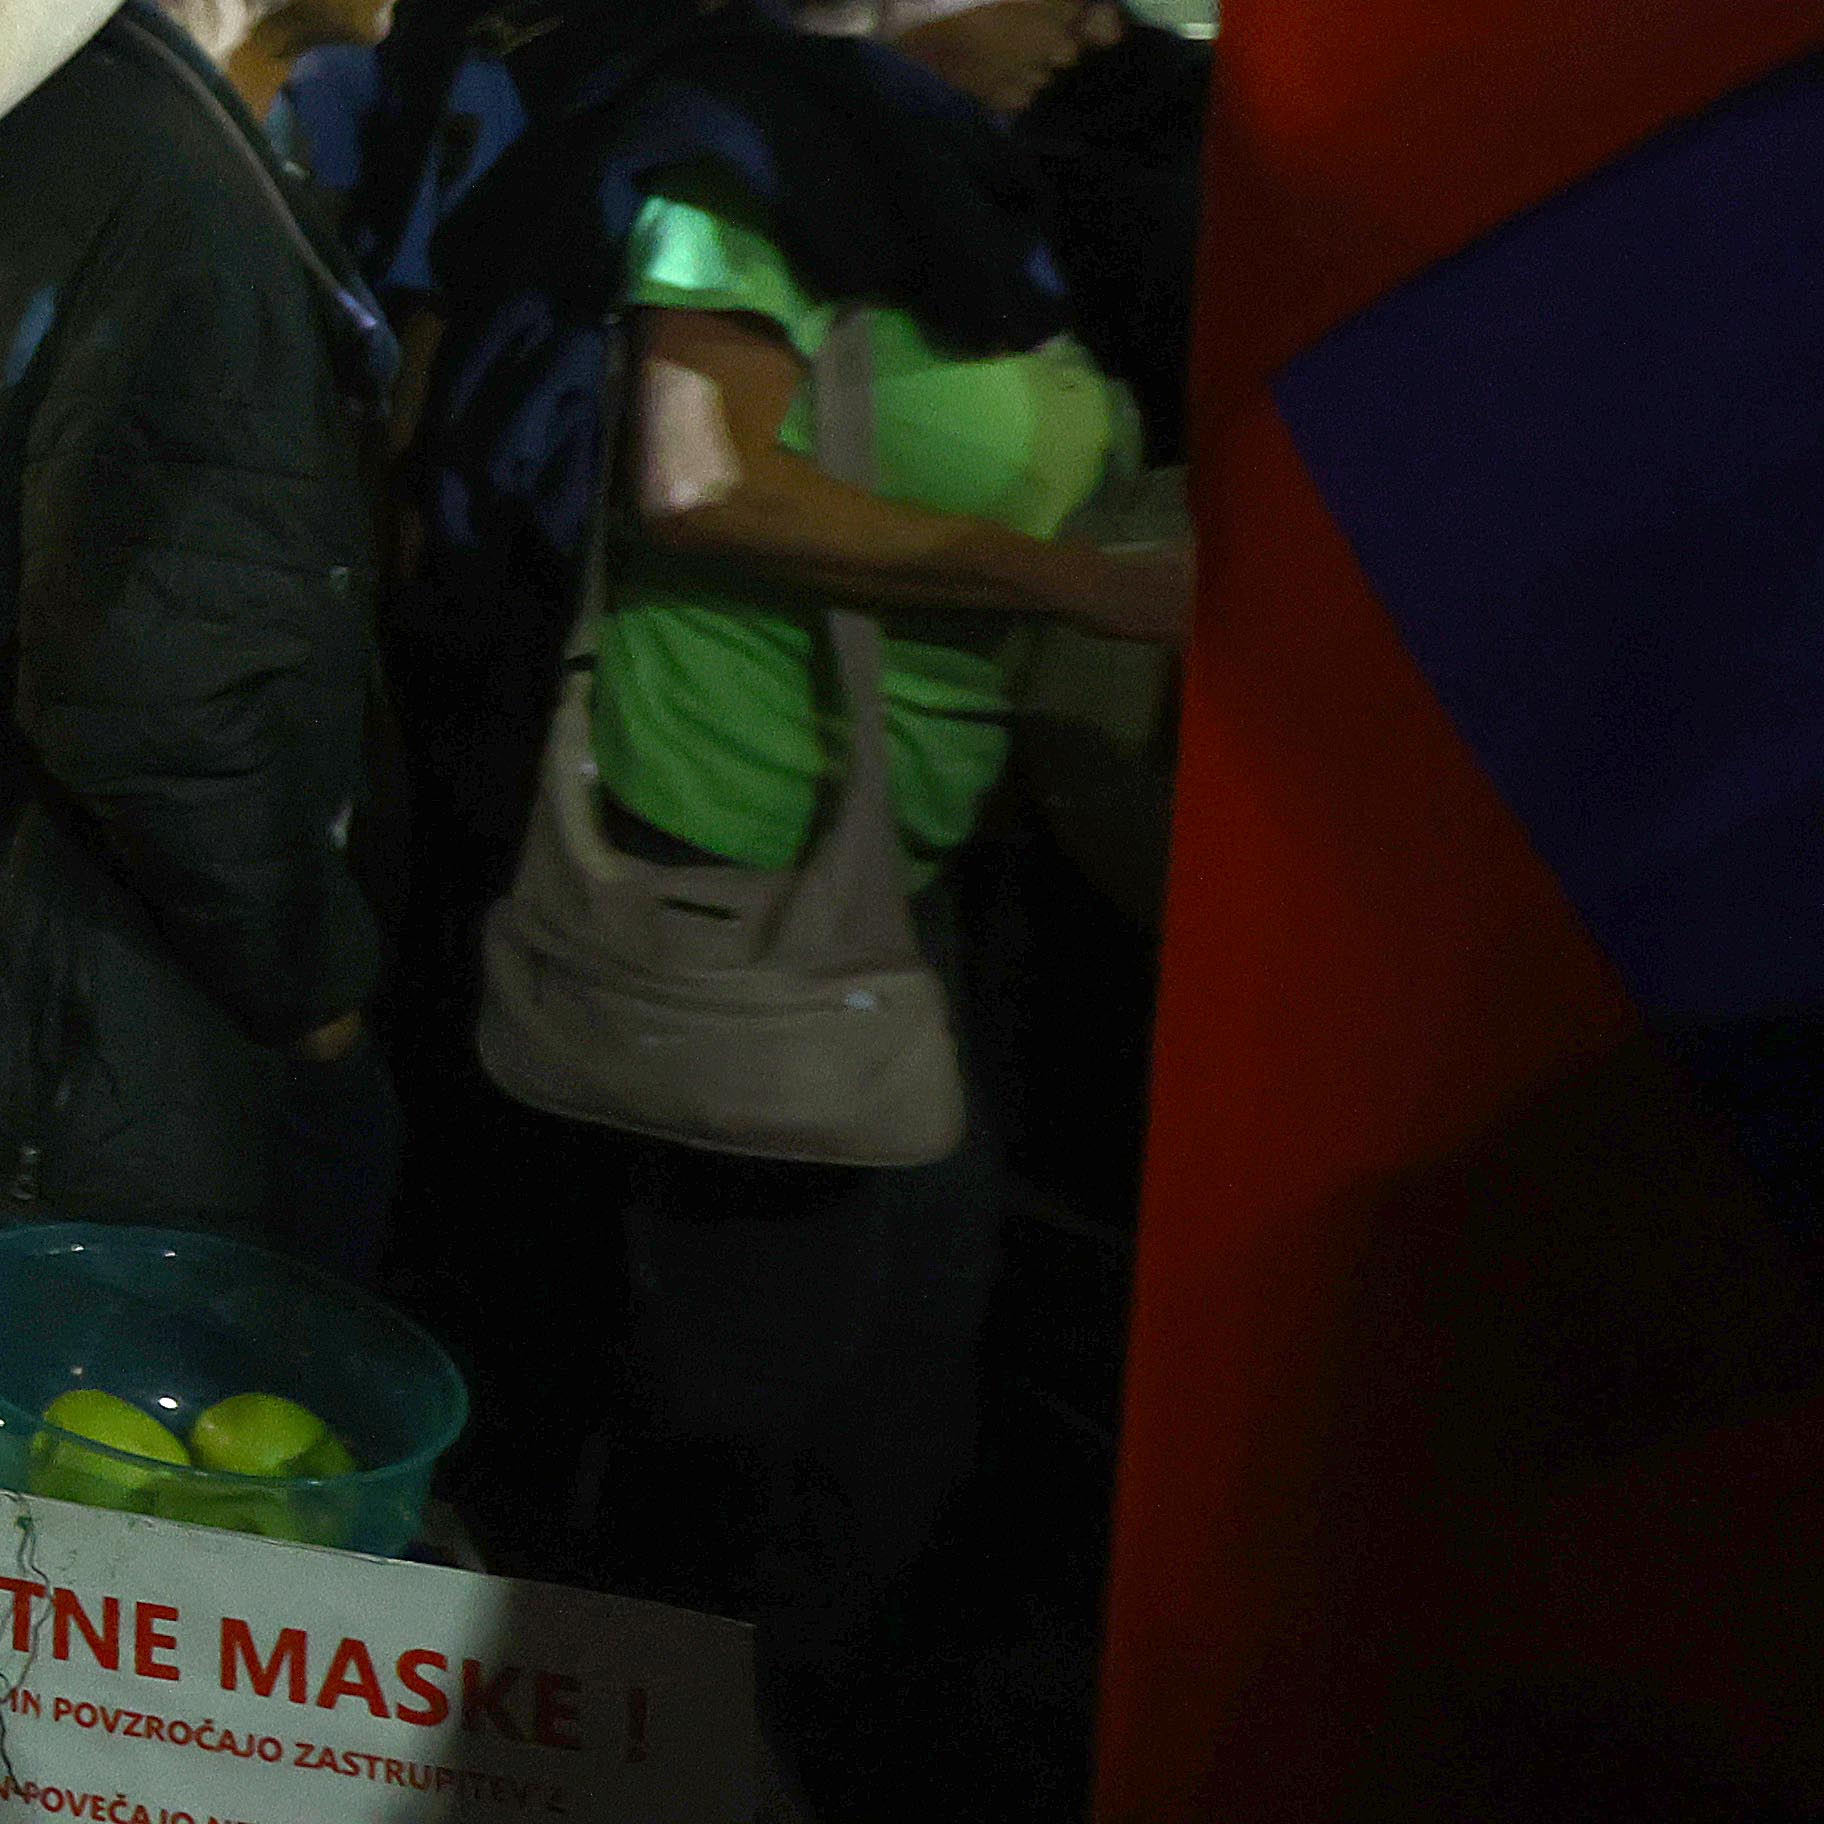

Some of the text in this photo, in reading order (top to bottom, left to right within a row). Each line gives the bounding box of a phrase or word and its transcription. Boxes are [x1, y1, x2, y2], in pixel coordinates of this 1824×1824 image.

[9, 1687, 43, 1719] IN
[54, 1696, 284, 1764] POVZROČAJO
[220, 1616, 581, 1751] MASKE
